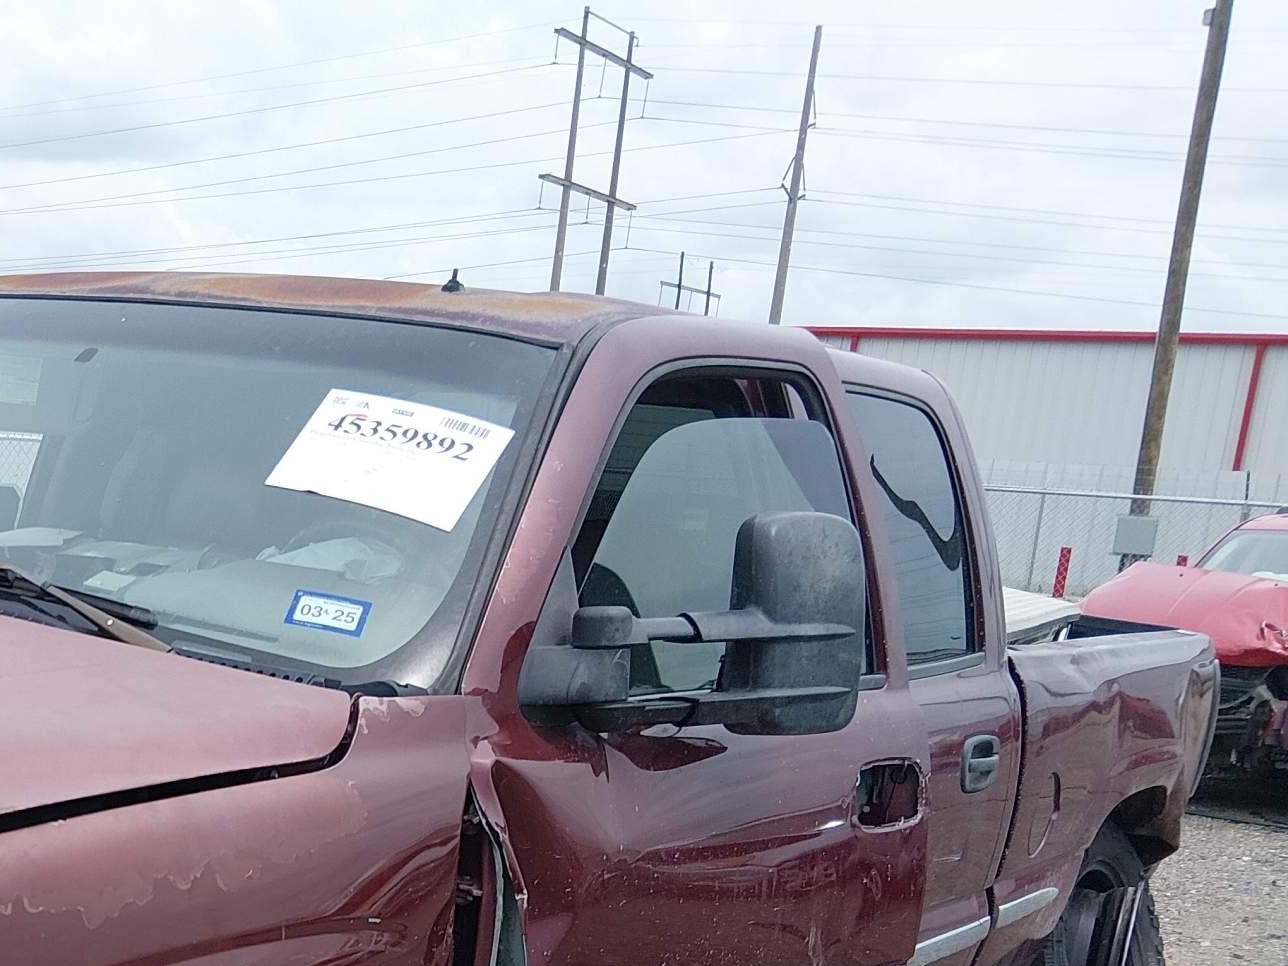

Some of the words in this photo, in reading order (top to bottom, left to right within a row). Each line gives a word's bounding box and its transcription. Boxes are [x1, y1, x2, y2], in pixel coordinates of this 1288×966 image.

[328, 415, 474, 461] 45359892
[300, 603, 324, 618] 03
[331, 609, 357, 624] 25
